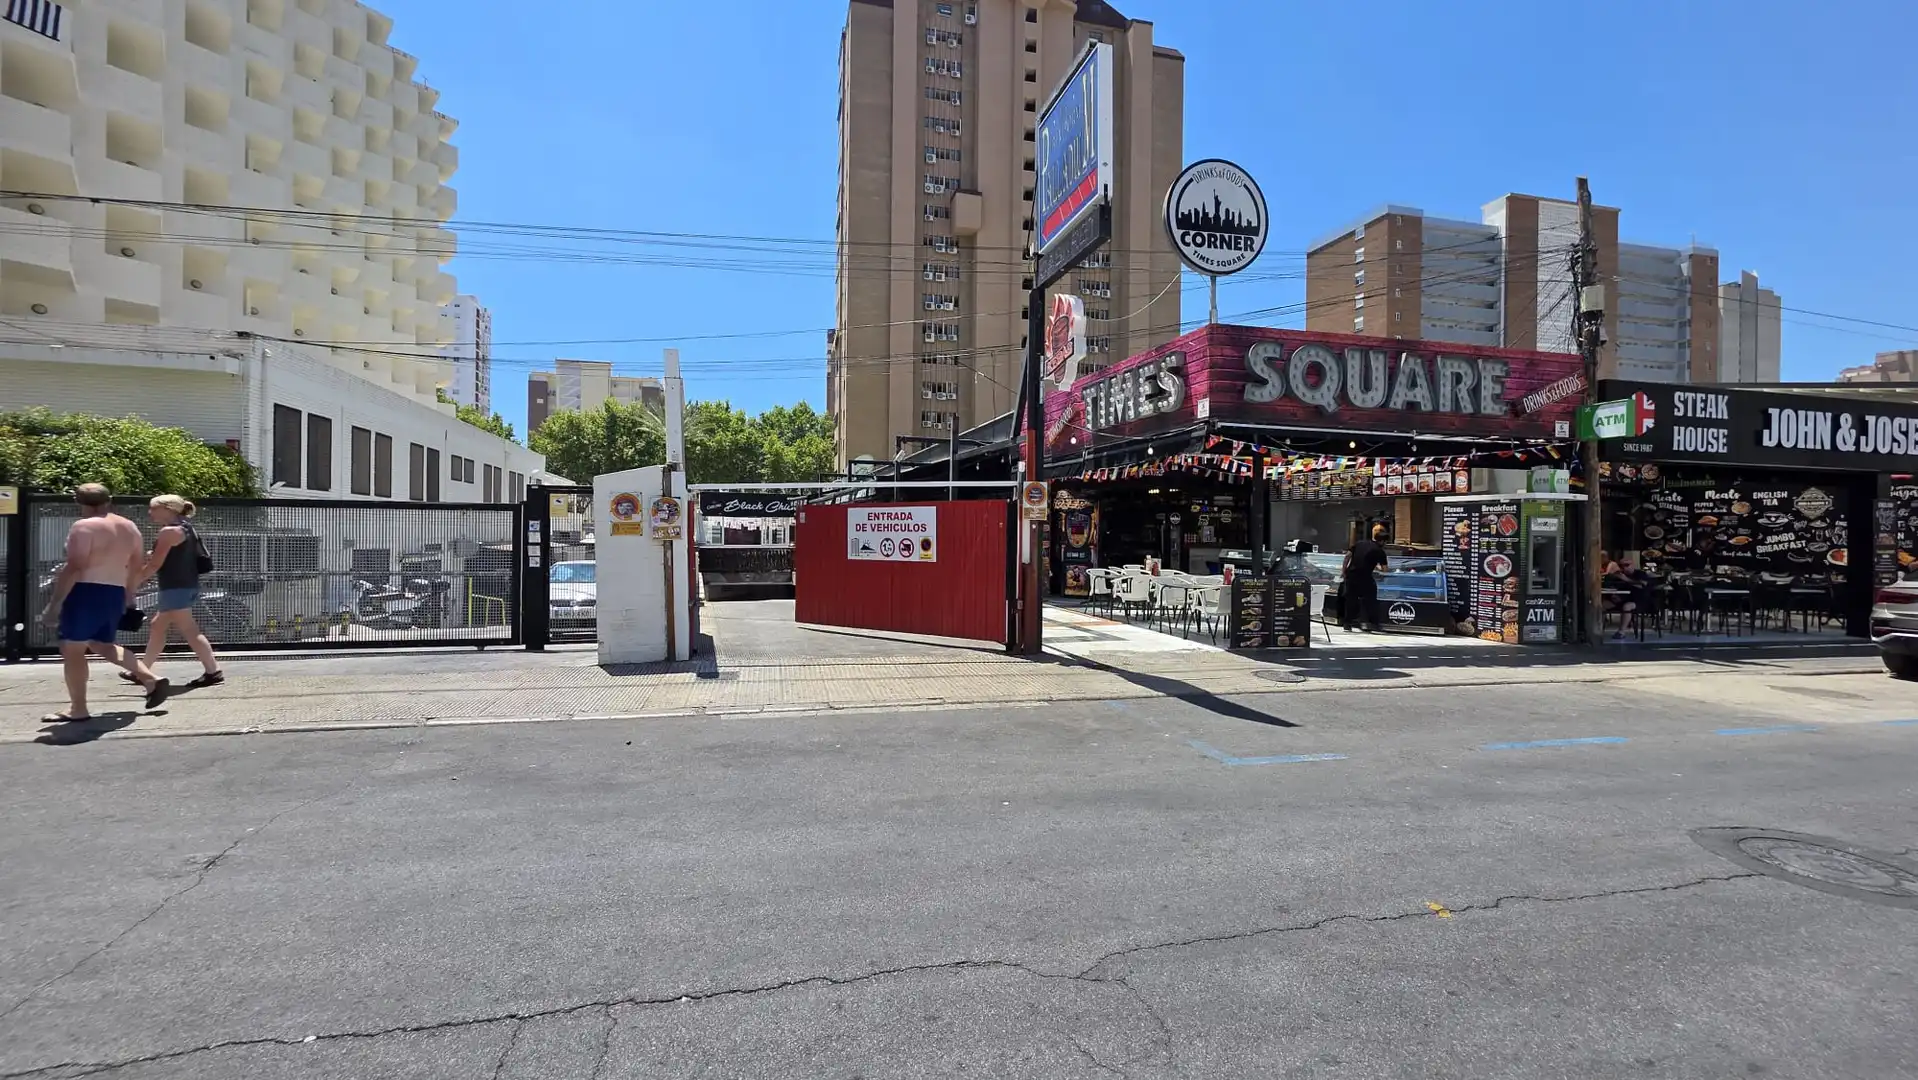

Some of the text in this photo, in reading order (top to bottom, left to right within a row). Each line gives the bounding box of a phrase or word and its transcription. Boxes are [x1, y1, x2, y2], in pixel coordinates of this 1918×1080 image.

[1180, 231, 1255, 252] CORNER
[1193, 250, 1246, 267] TIMES SQUARE
[1082, 351, 1185, 430] TIMES
[1243, 341, 1510, 413] SQUARE
[1523, 373, 1582, 413] DRINKS&FOODS
[1674, 391, 1729, 420] STEAK
[1595, 413, 1625, 428] ATM
[1762, 407, 1832, 450] JOHN
[1836, 413, 1856, 452] &
[1673, 426, 1728, 453] HOUSE
[1623, 442, 1653, 453] SINCE 1987
[1705, 488, 1740, 500] Meals
[1752, 491, 1788, 499] ENGLISH
[723, 499, 763, 512] Black
[1481, 504, 1517, 512] Breakfast
[867, 511, 913, 521] ENTRADA
[855, 523, 927, 532] DE VEHICULOS
[1764, 532, 1796, 544] JUMBO
[1756, 540, 1807, 553] BREAKFAST
[1527, 608, 1555, 622] ATM
